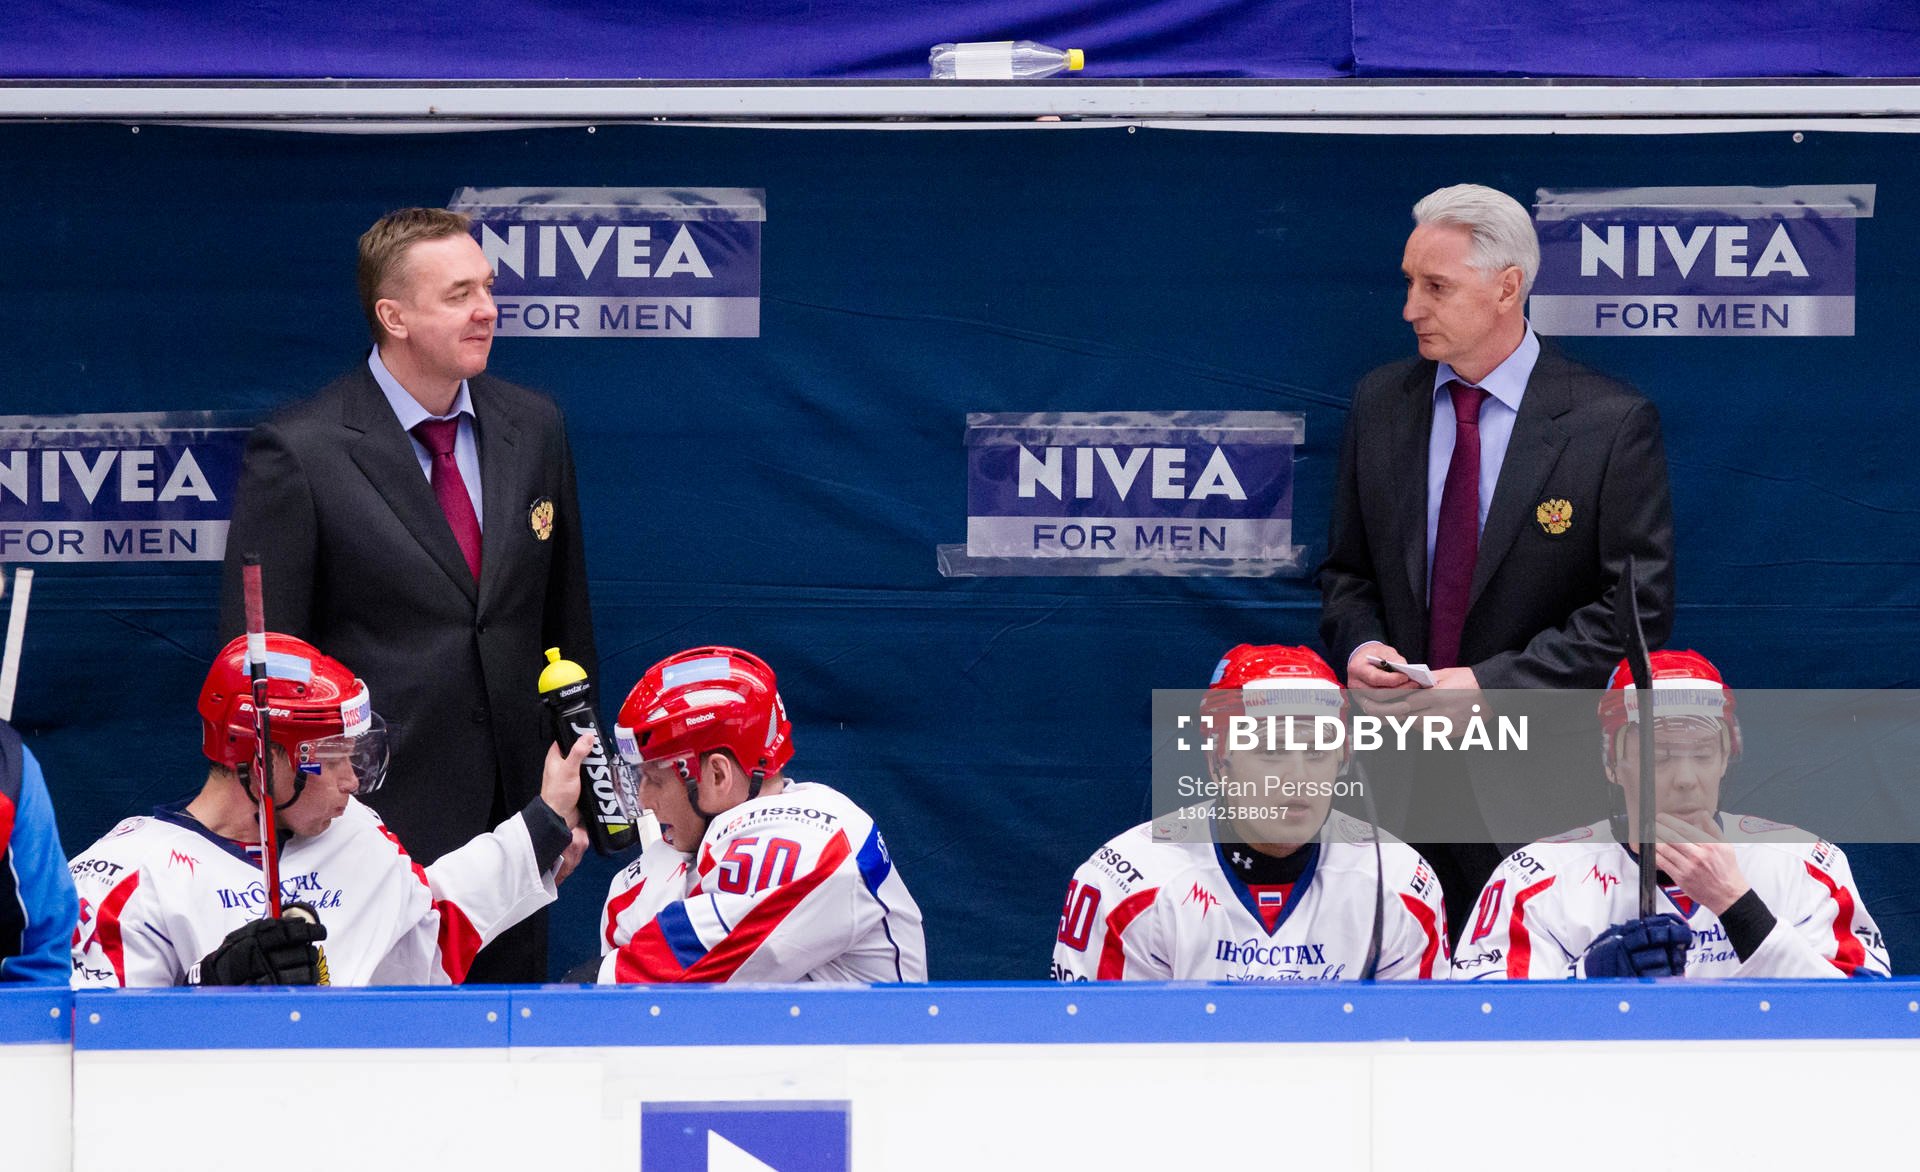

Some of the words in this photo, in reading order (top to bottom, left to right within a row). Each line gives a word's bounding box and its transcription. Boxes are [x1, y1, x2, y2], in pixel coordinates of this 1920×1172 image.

[482, 223, 713, 280] NIVEA
[1581, 222, 1809, 279] NIVEA
[497, 303, 580, 330] FOR
[600, 304, 692, 330] MEN
[1596, 303, 1678, 329] FOR
[1697, 303, 1789, 329] MEN
[0, 447, 217, 505] NIVEA
[1018, 443, 1248, 501] NIVEA
[0, 529, 84, 555] FOR
[104, 528, 197, 554] MEN
[1033, 524, 1117, 551] FOR
[1135, 525, 1226, 551] MEN
[240, 703, 290, 717] BER
[686, 712, 715, 726] Reebok
[748, 806, 837, 825] TISSOT
[718, 837, 801, 895] 50
